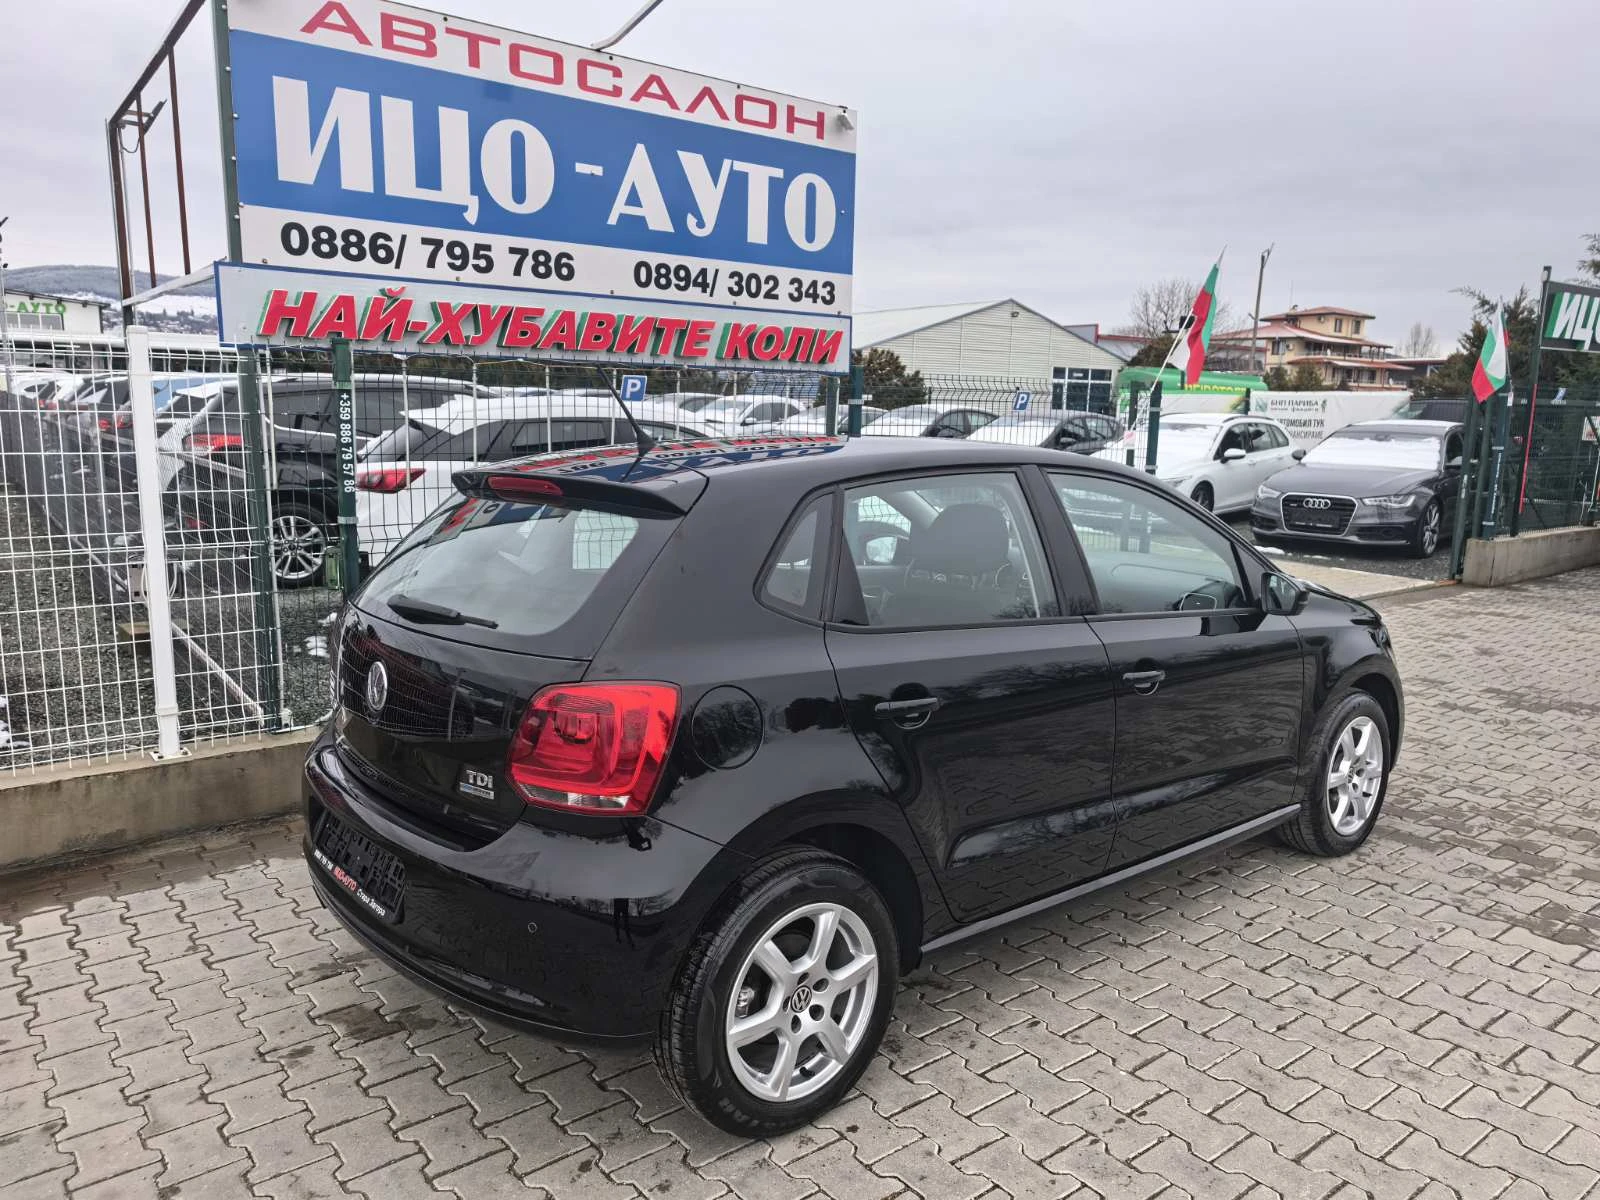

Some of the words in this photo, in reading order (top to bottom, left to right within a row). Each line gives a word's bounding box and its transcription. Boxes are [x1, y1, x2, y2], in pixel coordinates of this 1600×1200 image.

[300, 0, 825, 140] АВТОСАЛОН
[280, 222, 407, 269] 0886/
[420, 236, 495, 274] 795
[507, 246, 576, 282] 786
[633, 260, 720, 298] 0894/
[727, 270, 780, 301] 302
[787, 276, 837, 306] 343
[256, 285, 717, 360] НАЙ-ХУБАВИТЕ
[716, 320, 845, 366] КОЛИ
[1547, 291, 1600, 351] ИЦ
[625, 378, 642, 399] P
[339, 392, 352, 421] +359
[1016, 393, 1026, 410] P
[340, 422, 353, 444] 886
[341, 446, 353, 460] 79
[342, 463, 354, 477] 57
[343, 479, 356, 493] 86
